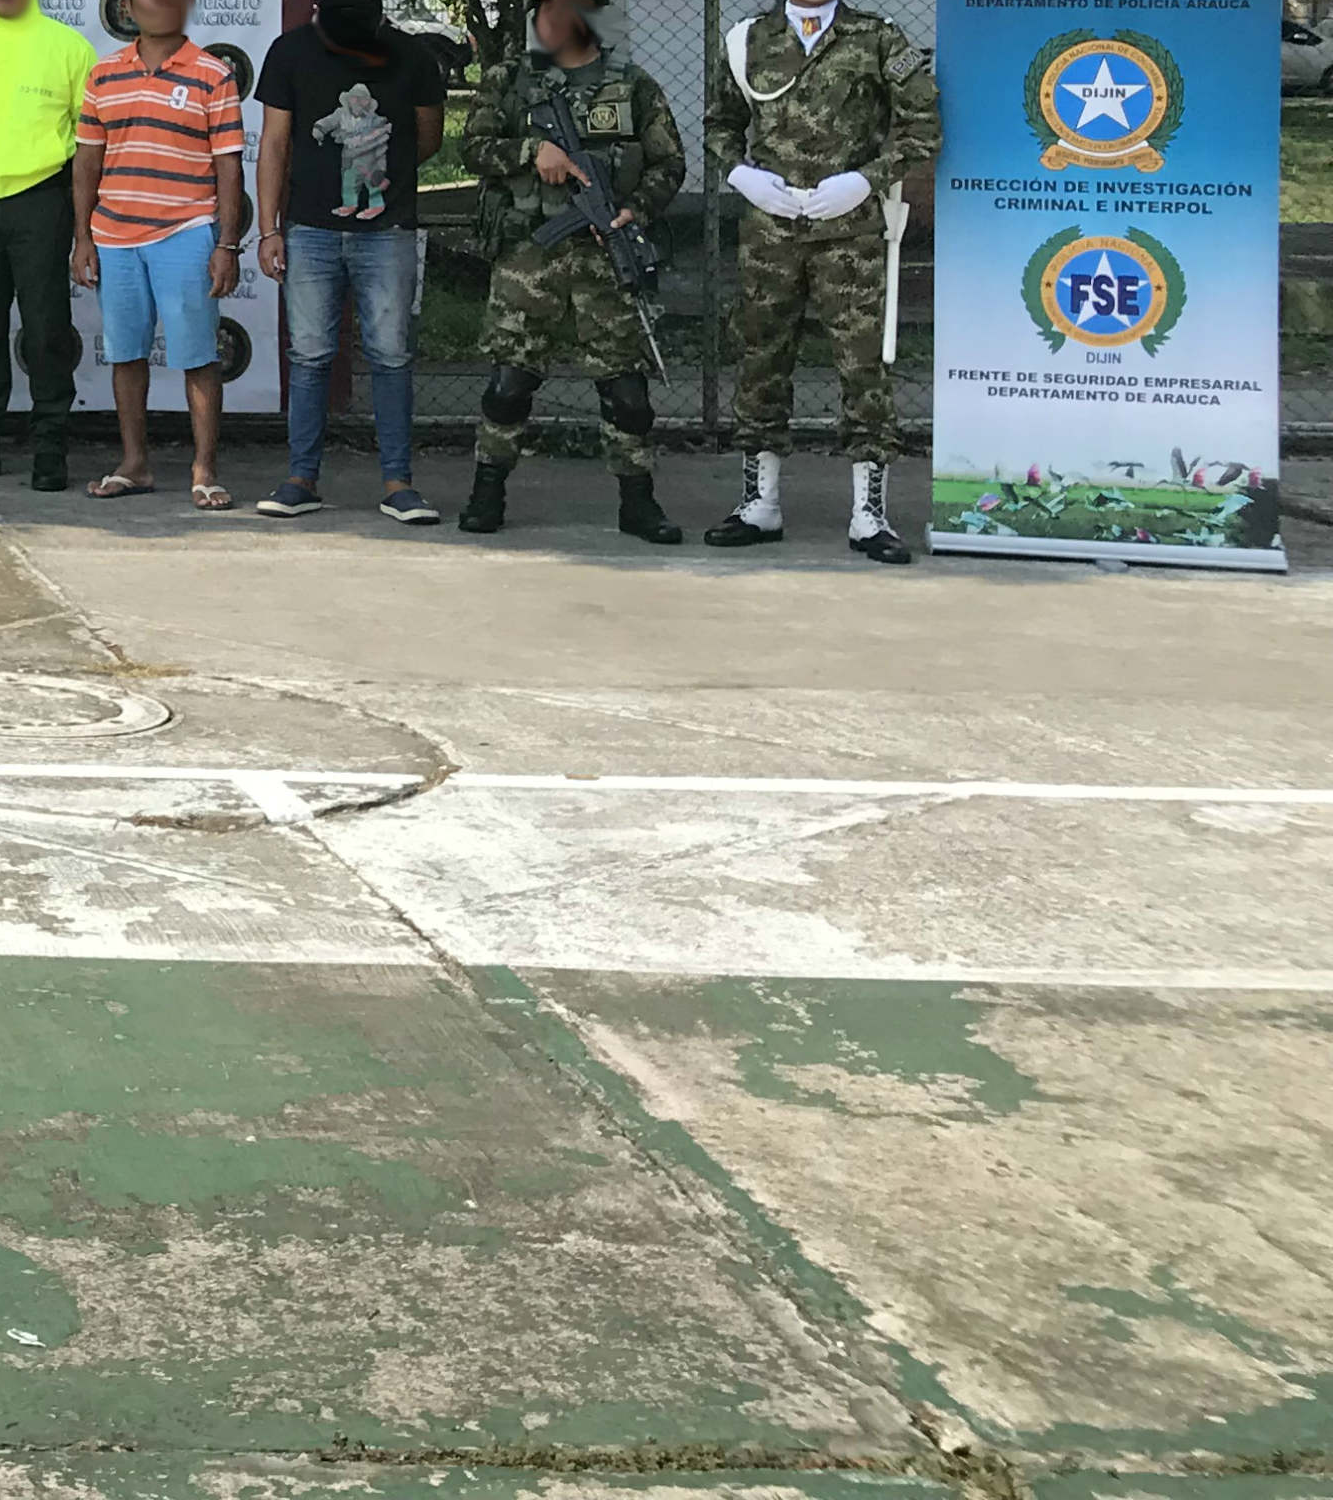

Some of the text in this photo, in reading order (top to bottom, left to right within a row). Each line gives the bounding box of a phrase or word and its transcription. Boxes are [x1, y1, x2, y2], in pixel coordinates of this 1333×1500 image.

[1119, 0, 1180, 9] POLICIA
[1186, 0, 1250, 10] ARAUCA
[891, 49, 923, 76] PM
[169, 84, 189, 109] 9
[1082, 87, 1127, 98] DIJIN
[950, 176, 1252, 197] DIRECCIÓN DE INVESTIGACIÓN
[994, 197, 1213, 215] CRIMINAL E INTERPOL
[1070, 273, 1140, 316] FSE
[1085, 351, 1122, 364] DIJIN
[948, 368, 1263, 392] FRENTE DE SEGURIDAD EMPRESARIAL
[987, 386, 1221, 406] DEPARTAMENTO DE ARAUCA
